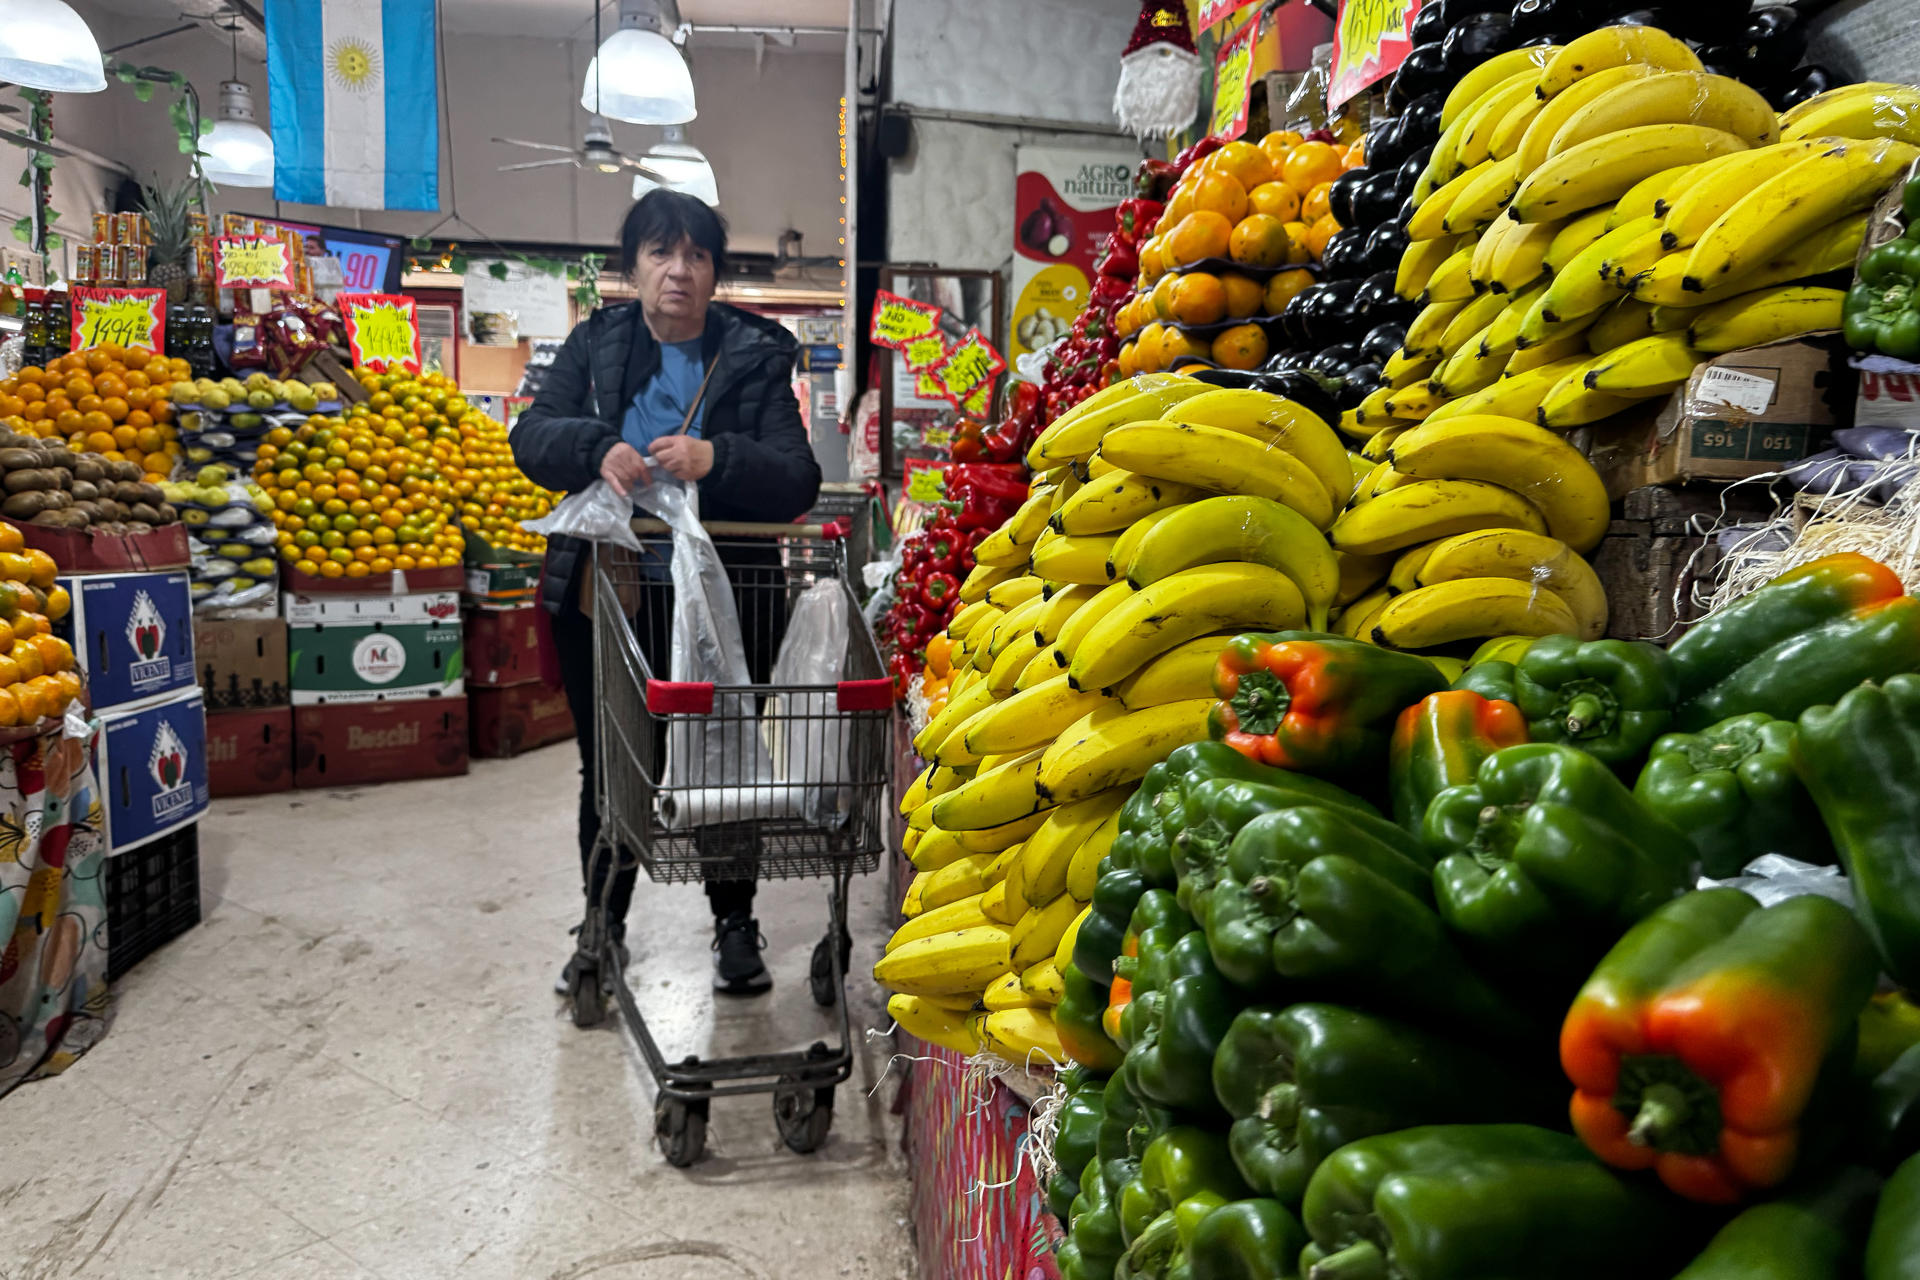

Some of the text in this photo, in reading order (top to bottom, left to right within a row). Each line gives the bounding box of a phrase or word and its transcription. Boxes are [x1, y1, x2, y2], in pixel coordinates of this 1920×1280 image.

[1077, 165, 1130, 181] AGRO
[343, 252, 378, 290] 90
[90, 316, 133, 348] 1494
[1703, 431, 1734, 448] 165
[1762, 434, 1791, 450] 150
